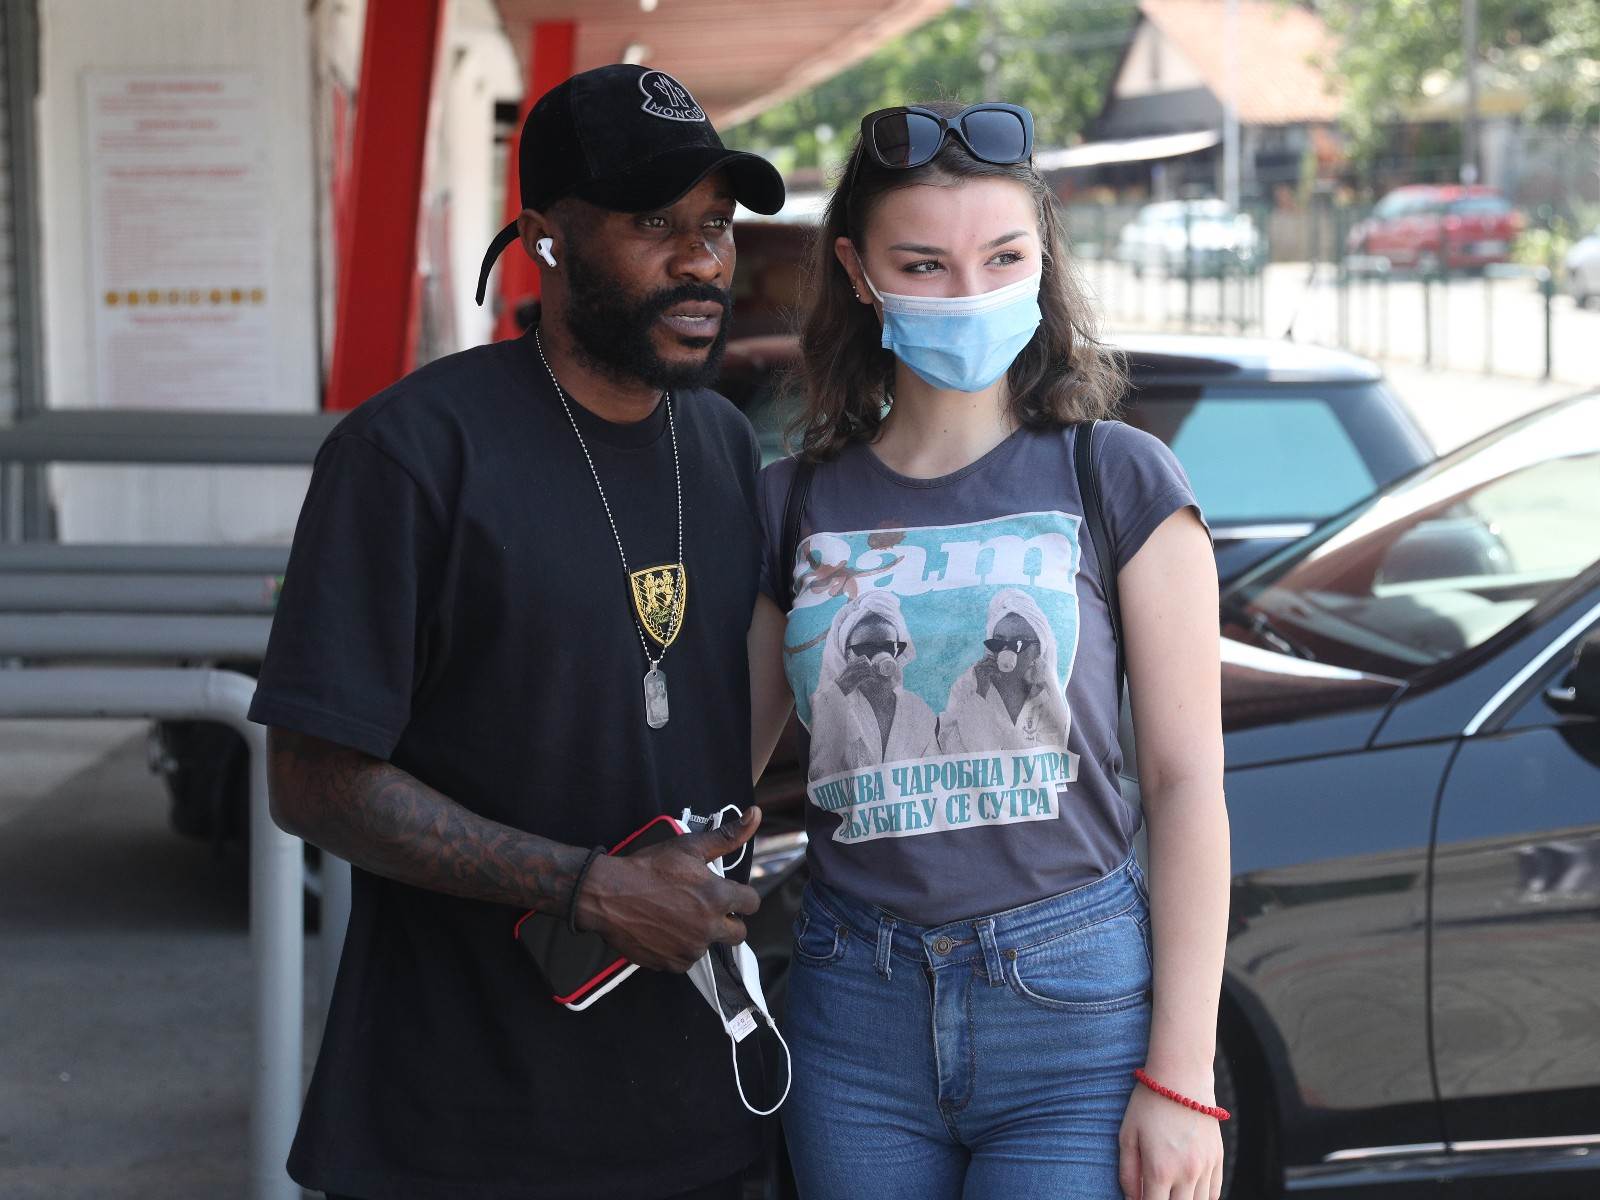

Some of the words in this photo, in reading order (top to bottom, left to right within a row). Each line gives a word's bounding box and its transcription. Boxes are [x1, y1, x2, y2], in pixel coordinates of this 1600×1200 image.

[891, 757, 1005, 797] ЧАРОБНА
[945, 794, 971, 825] СЕ
[978, 788, 1052, 820] СУТРА
